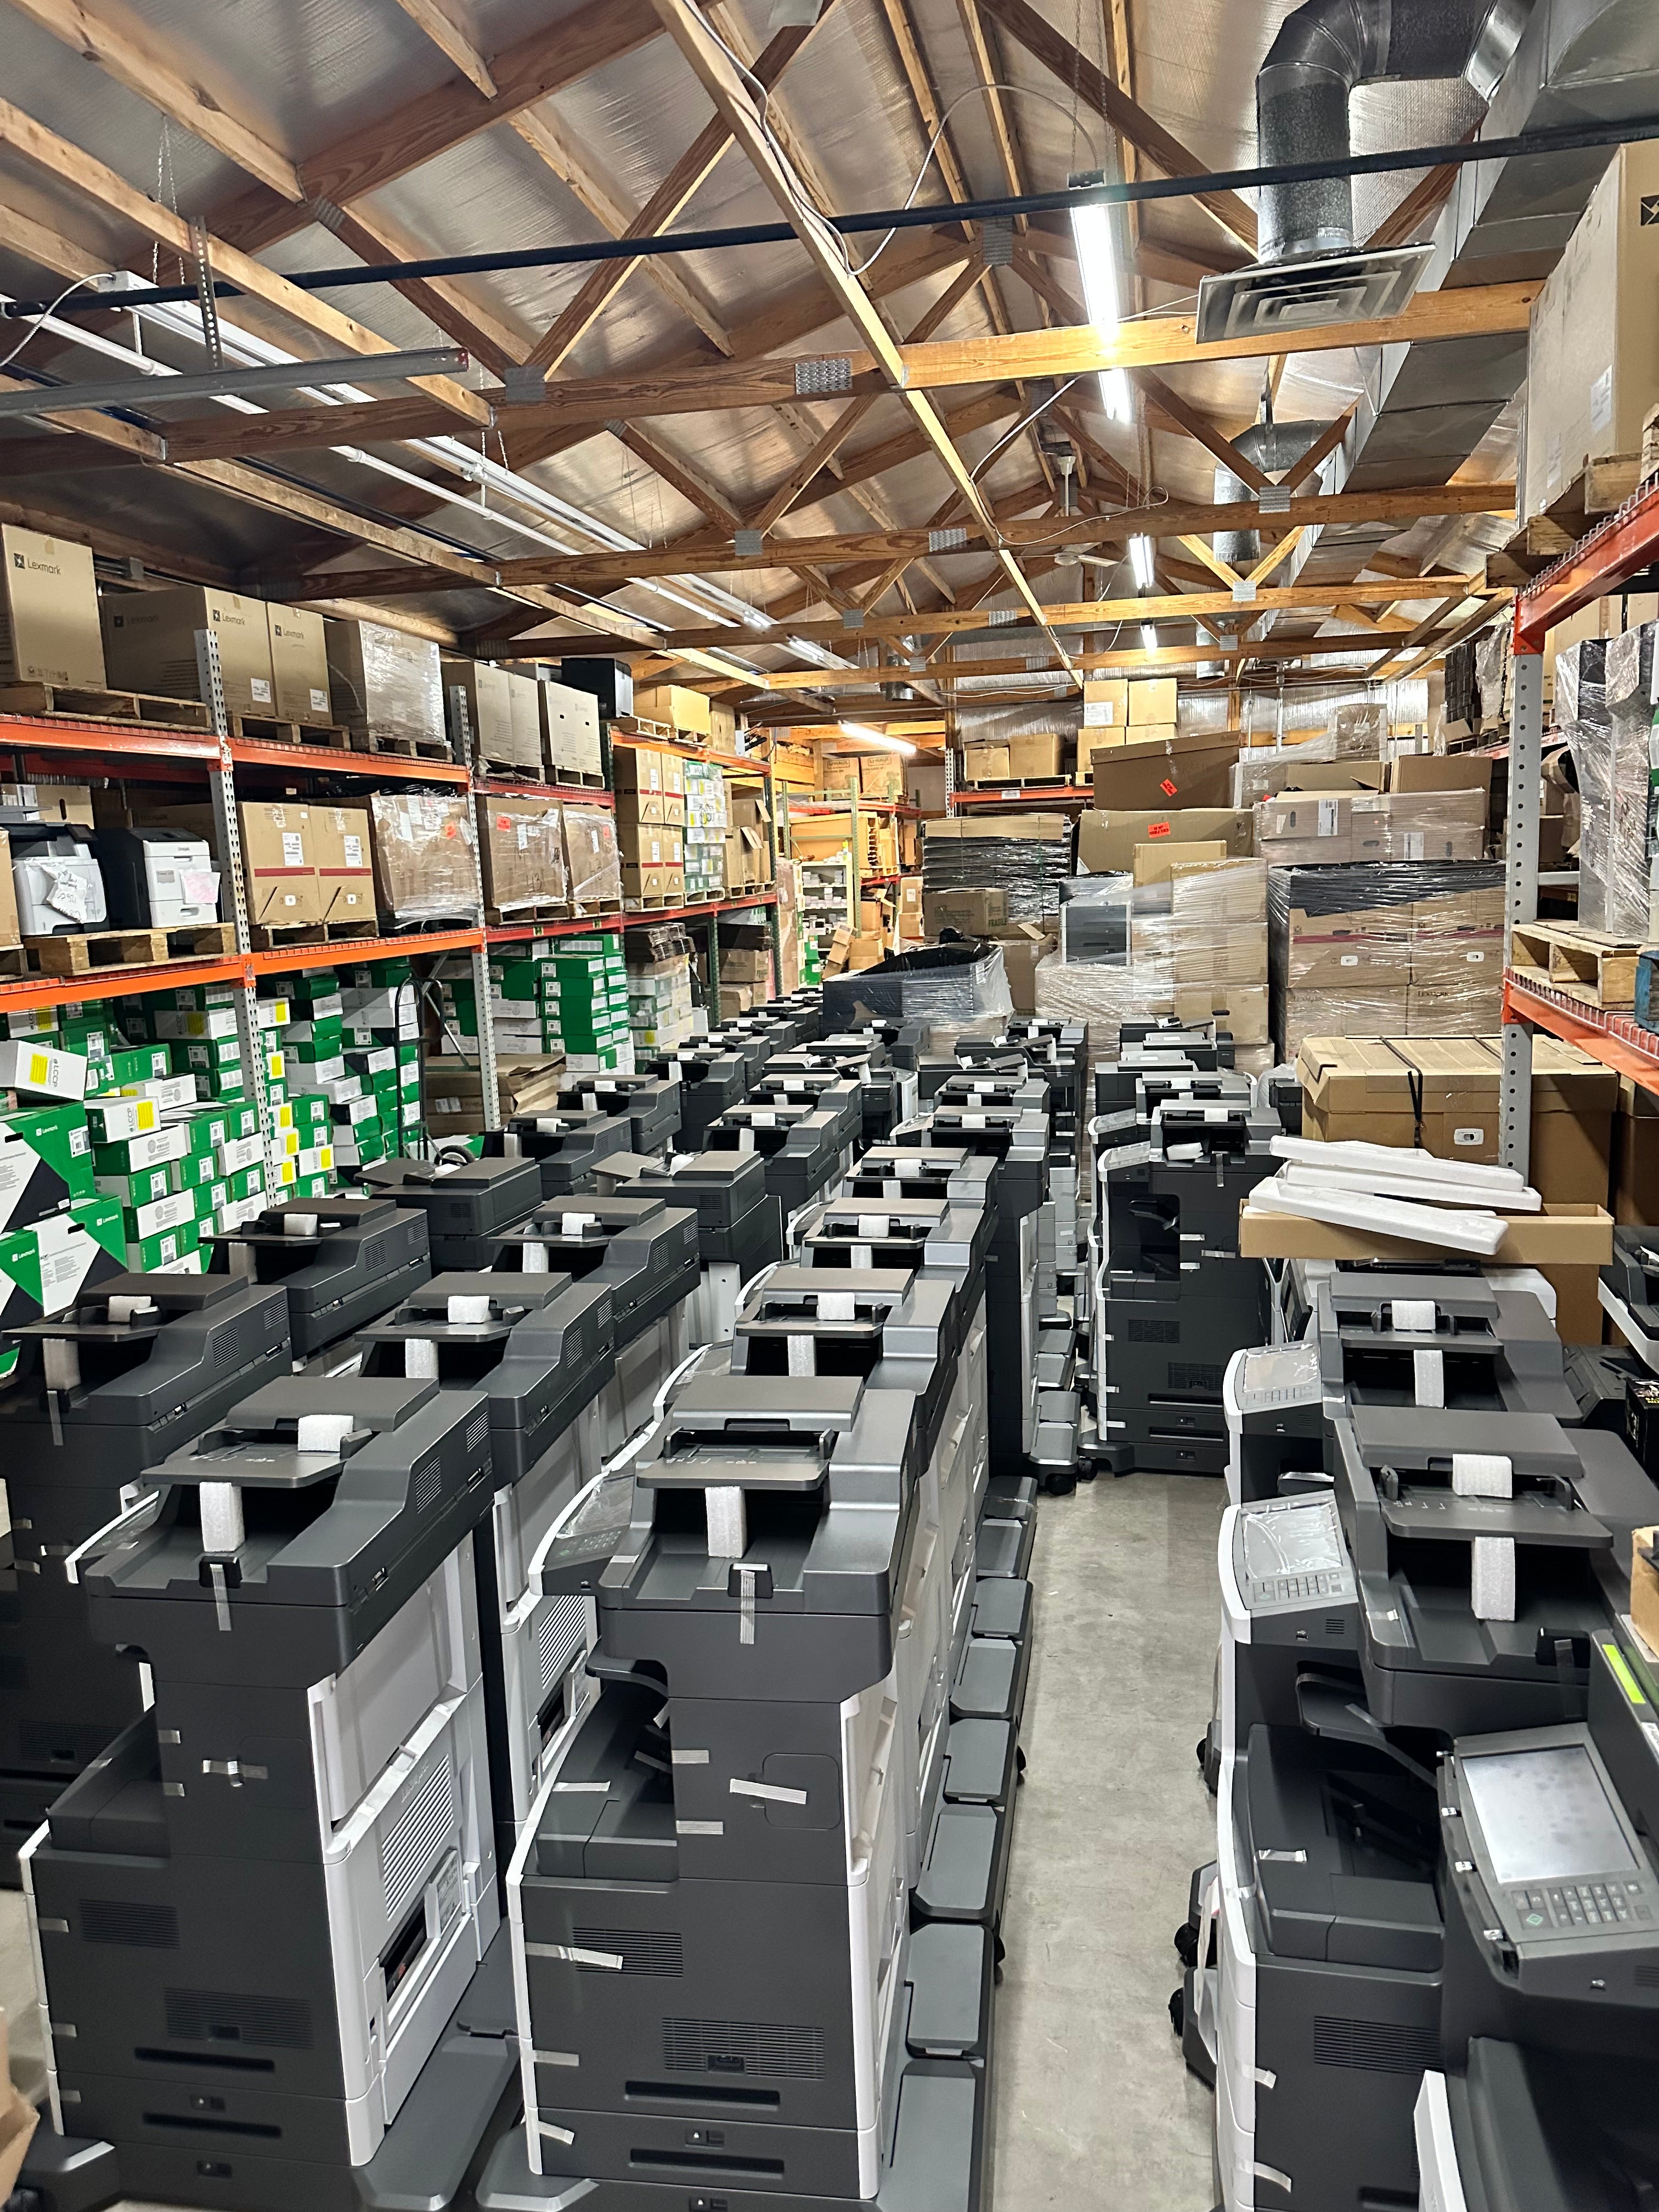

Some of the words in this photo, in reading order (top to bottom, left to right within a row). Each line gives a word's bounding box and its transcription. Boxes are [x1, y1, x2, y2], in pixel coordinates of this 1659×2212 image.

[27, 557, 61, 575] Lexmark
[222, 613, 245, 625] Lexmark
[283, 628, 304, 640] Lexmark
[988, 917, 1007, 927] FRAGILE
[42, 1124, 58, 1135] Lexmark
